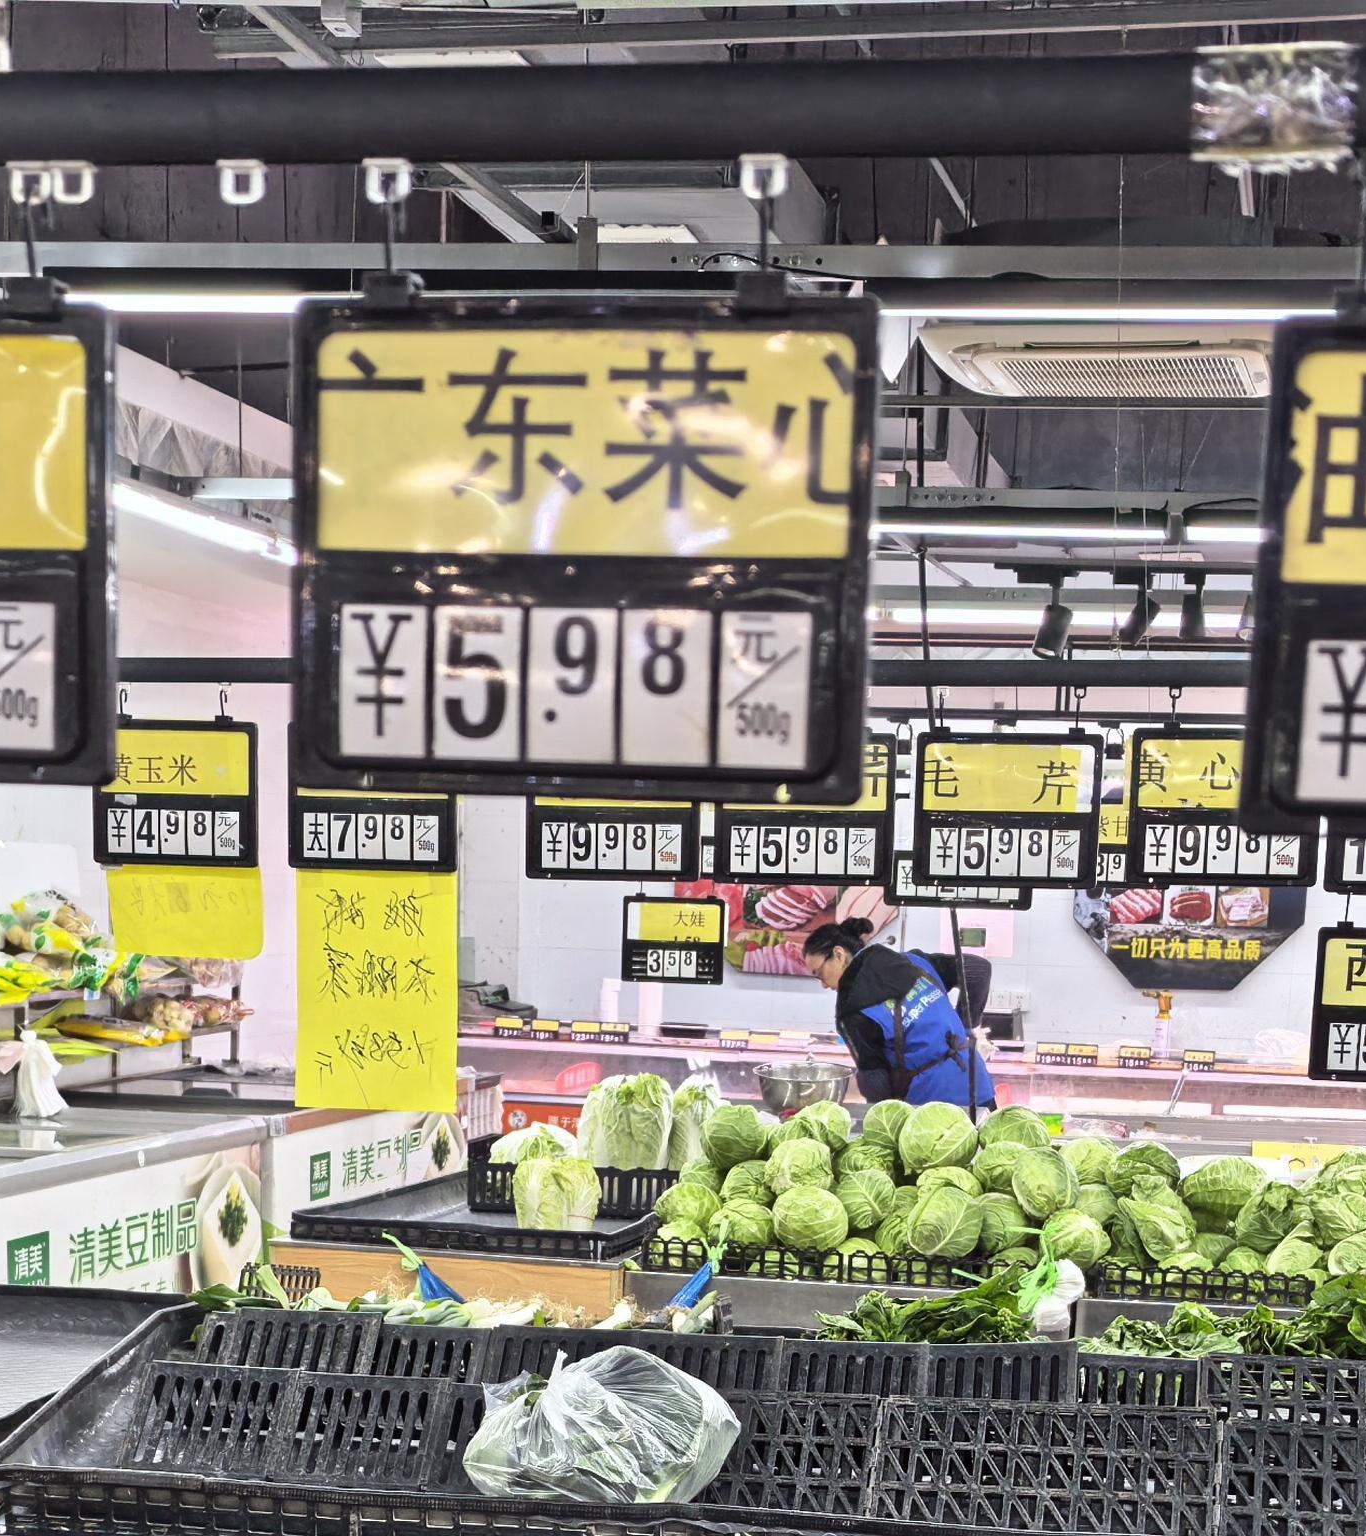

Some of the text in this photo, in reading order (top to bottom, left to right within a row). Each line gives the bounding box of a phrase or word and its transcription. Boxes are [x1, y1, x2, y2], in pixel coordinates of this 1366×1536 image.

[351, 613, 685, 742] ¥5.98
[115, 753, 197, 786] 黄玉米
[110, 810, 207, 848] ¥4.98
[545, 823, 647, 862] ¥9.98
[734, 828, 838, 867] ¥5.98
[1149, 825, 1260, 866] ¥9.98
[935, 829, 1043, 870] ¥5.98
[648, 951, 694, 974] 3.58
[1112, 938, 1261, 961] 一切只为更高品质
[69, 1199, 198, 1285] 清美豆制品
[14, 1243, 44, 1281] 清美
